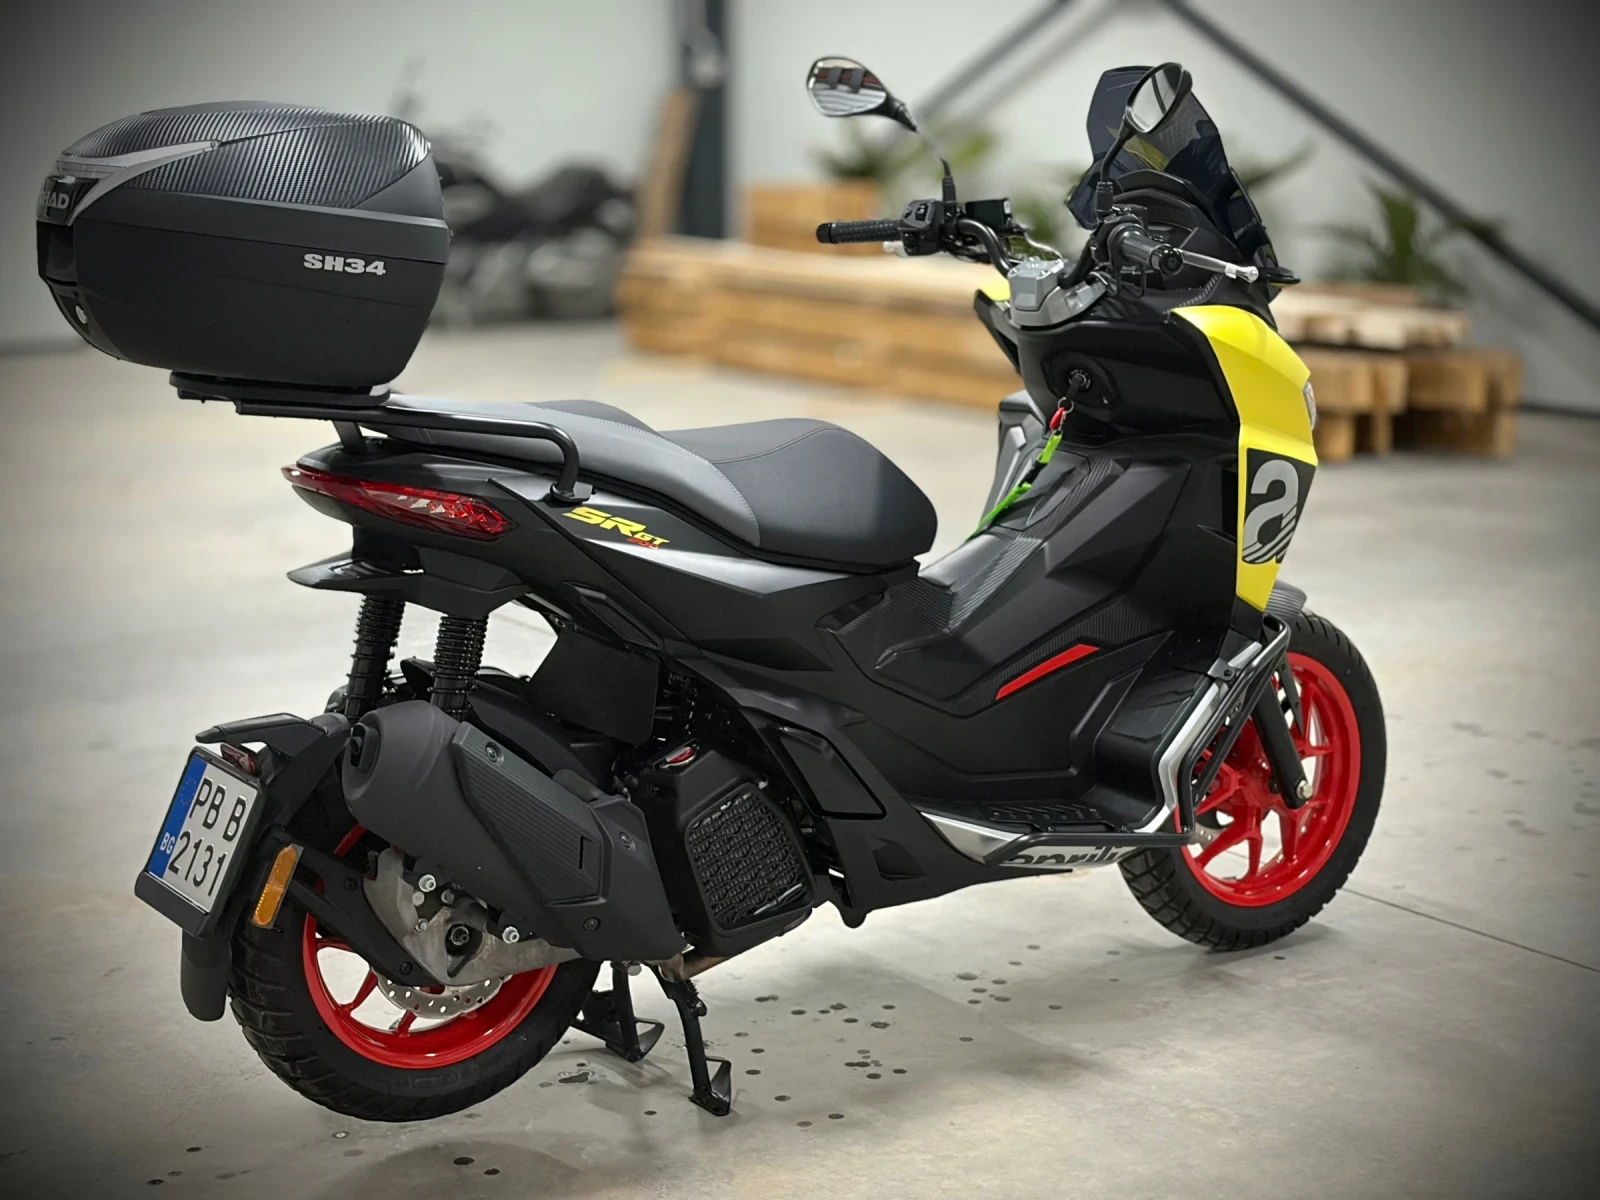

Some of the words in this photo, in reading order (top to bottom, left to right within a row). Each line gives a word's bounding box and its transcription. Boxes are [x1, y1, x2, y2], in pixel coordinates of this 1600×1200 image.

[303, 253, 387, 277] SH34
[188, 777, 226, 830] PB
[222, 794, 248, 843] B
[159, 831, 176, 855] BG
[167, 830, 229, 897] 2131
